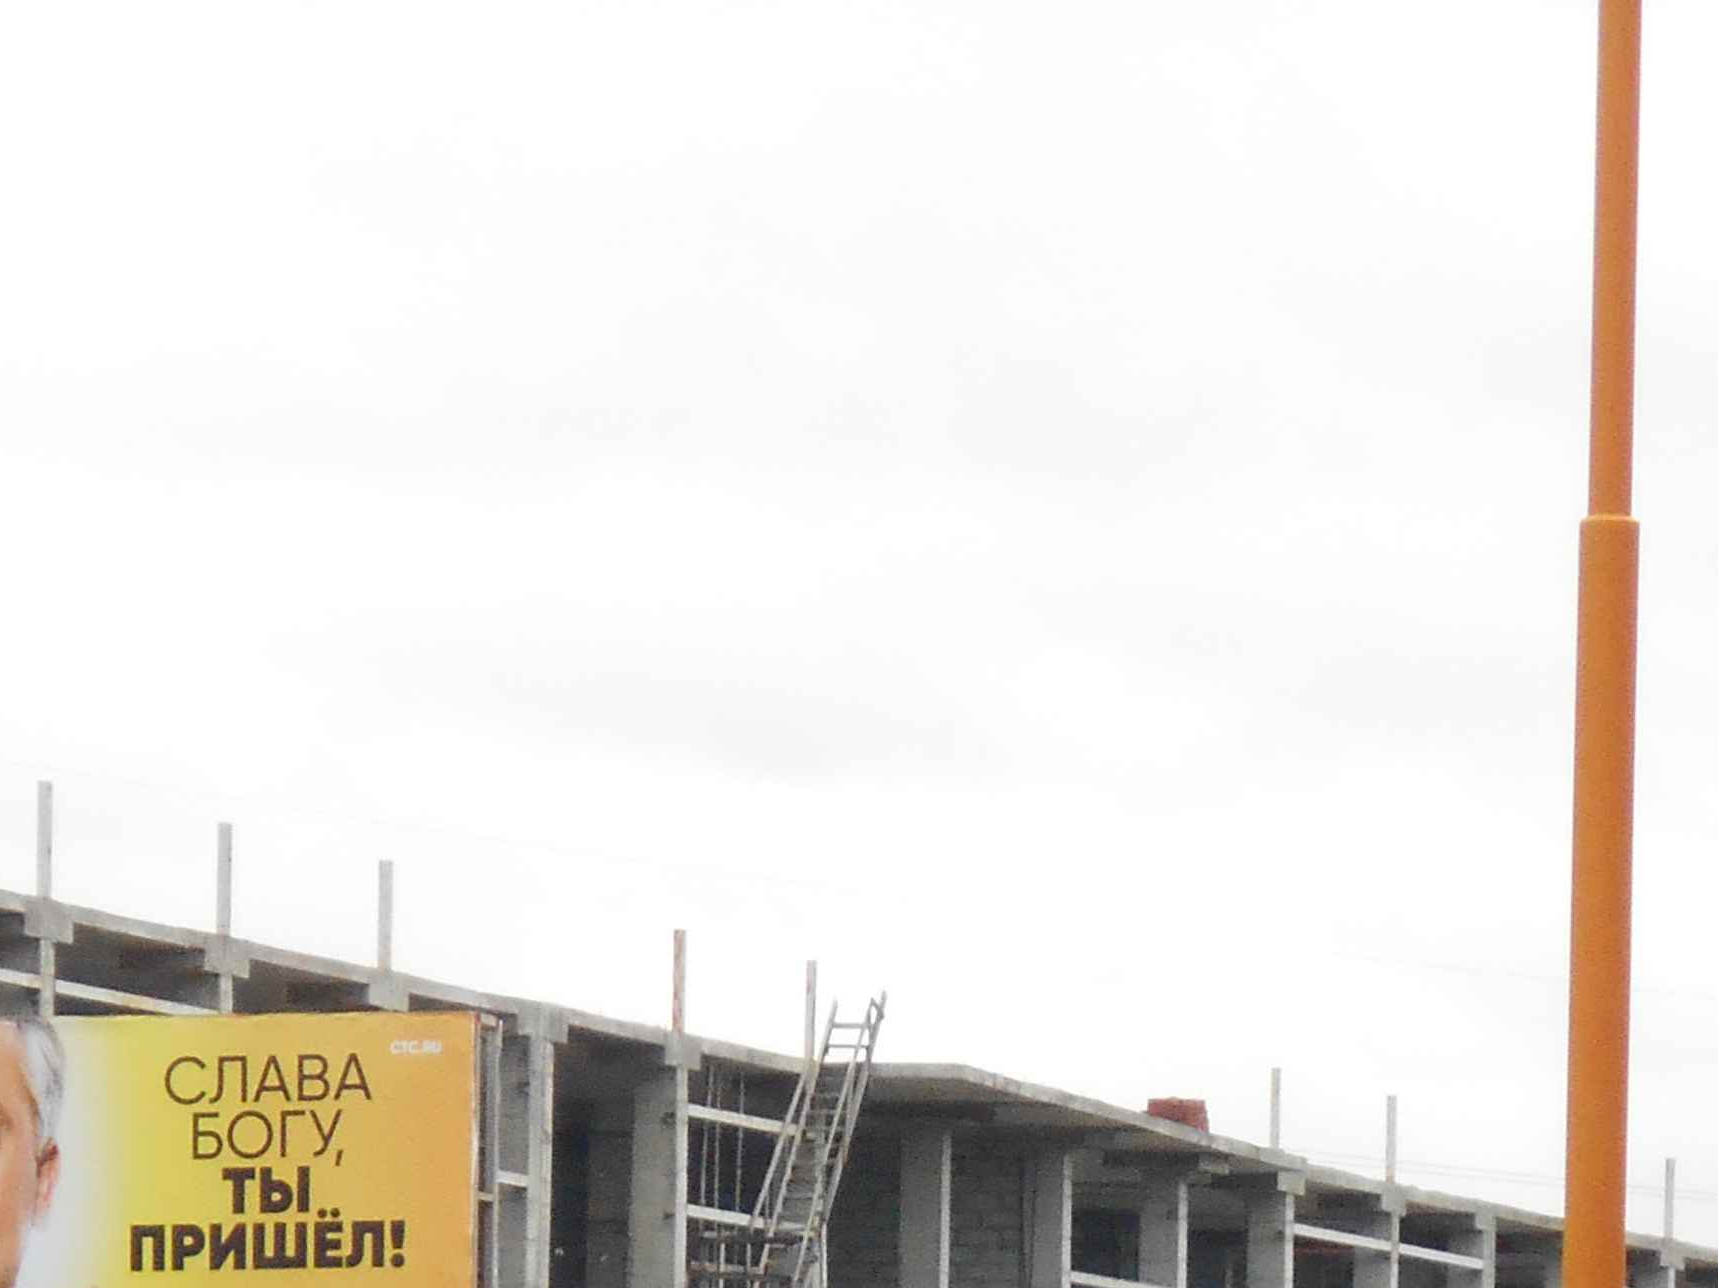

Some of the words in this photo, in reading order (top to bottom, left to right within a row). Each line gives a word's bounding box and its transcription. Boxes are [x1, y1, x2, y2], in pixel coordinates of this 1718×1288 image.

[164, 1053, 372, 1105] СЛАВА
[191, 1108, 344, 1167] БОГУ,
[221, 1166, 310, 1215] ТЫ
[130, 1207, 406, 1272] ПРИШЁЛ!
